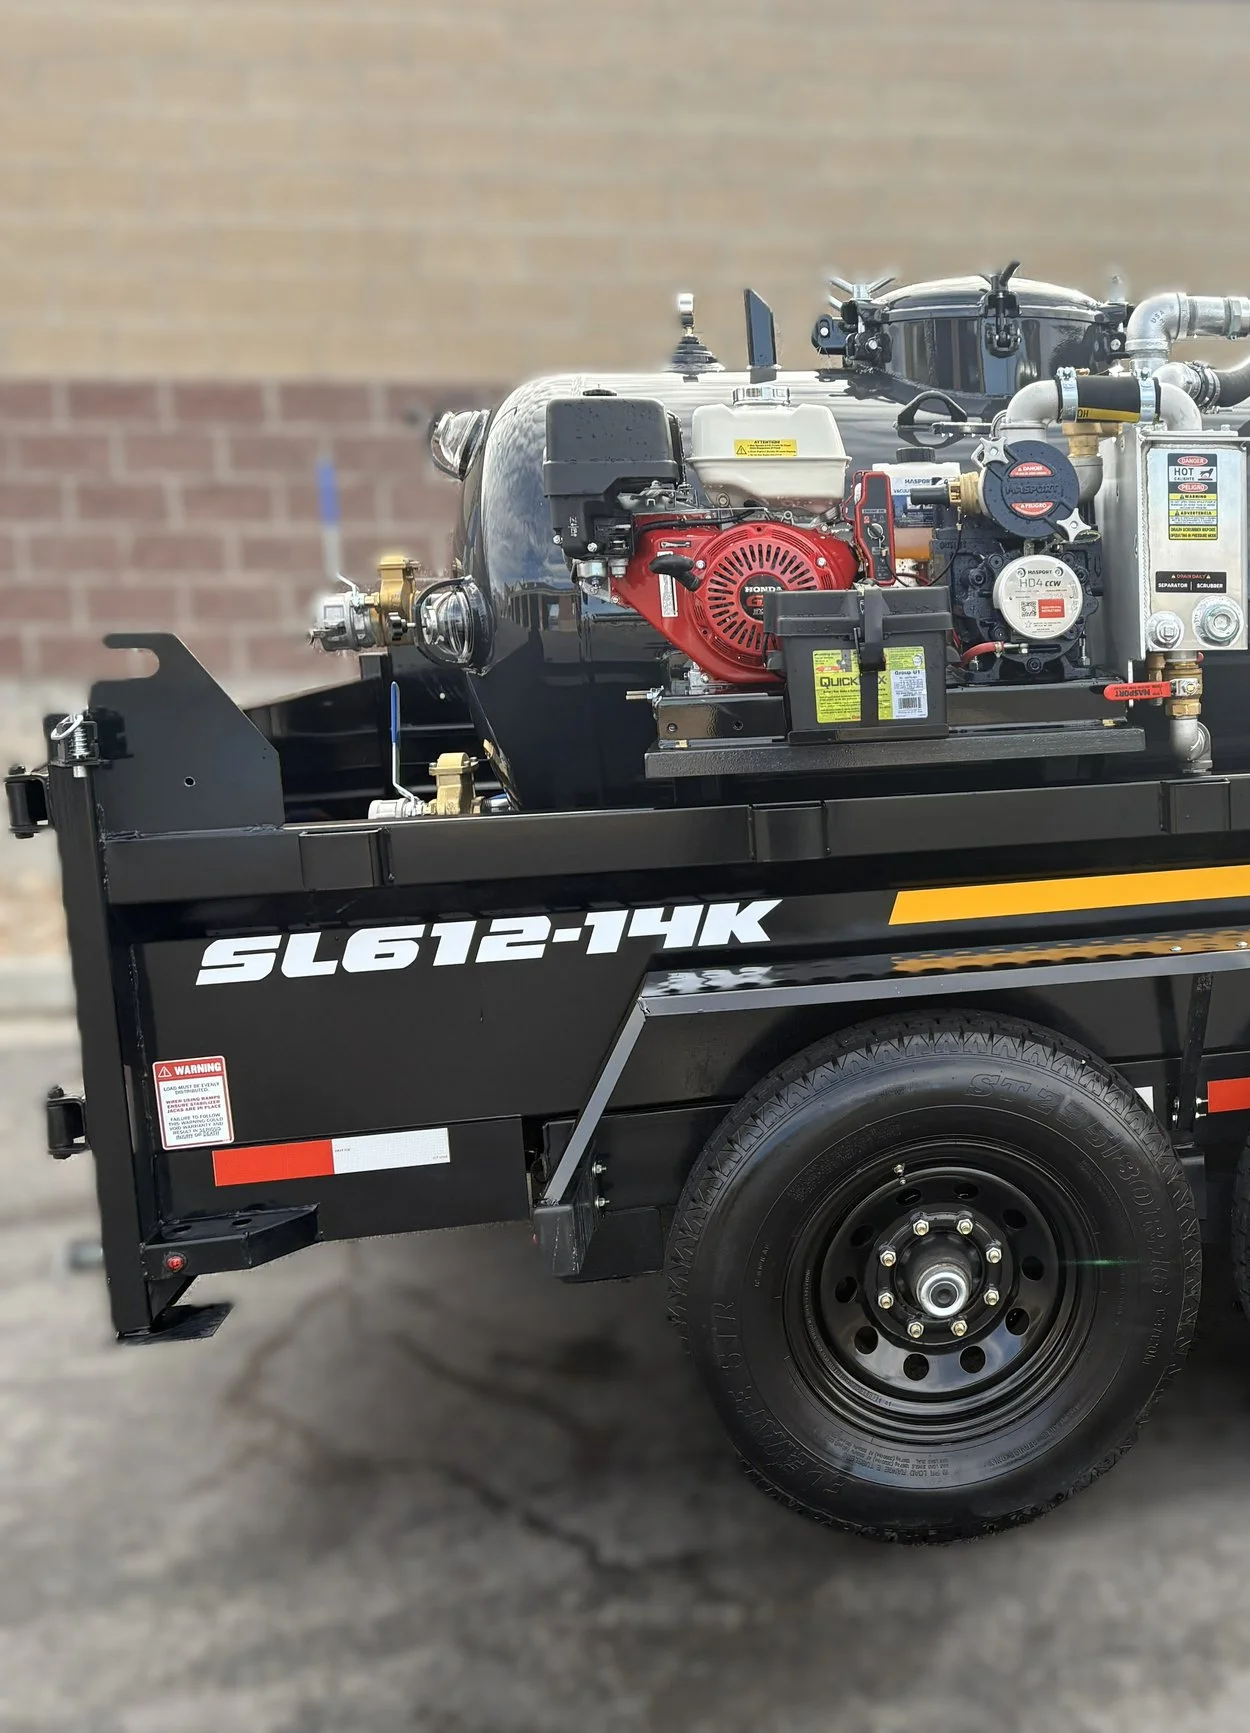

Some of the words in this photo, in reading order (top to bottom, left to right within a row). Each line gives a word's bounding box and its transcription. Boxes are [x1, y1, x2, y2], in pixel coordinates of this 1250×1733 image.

[1174, 468, 1194, 476] HOT
[1005, 484, 1059, 495] MASPORT
[1020, 578, 1042, 587] HD4
[746, 594, 764, 607] G
[195, 899, 784, 986] SL612-14K
[174, 1062, 222, 1075] WARNING
